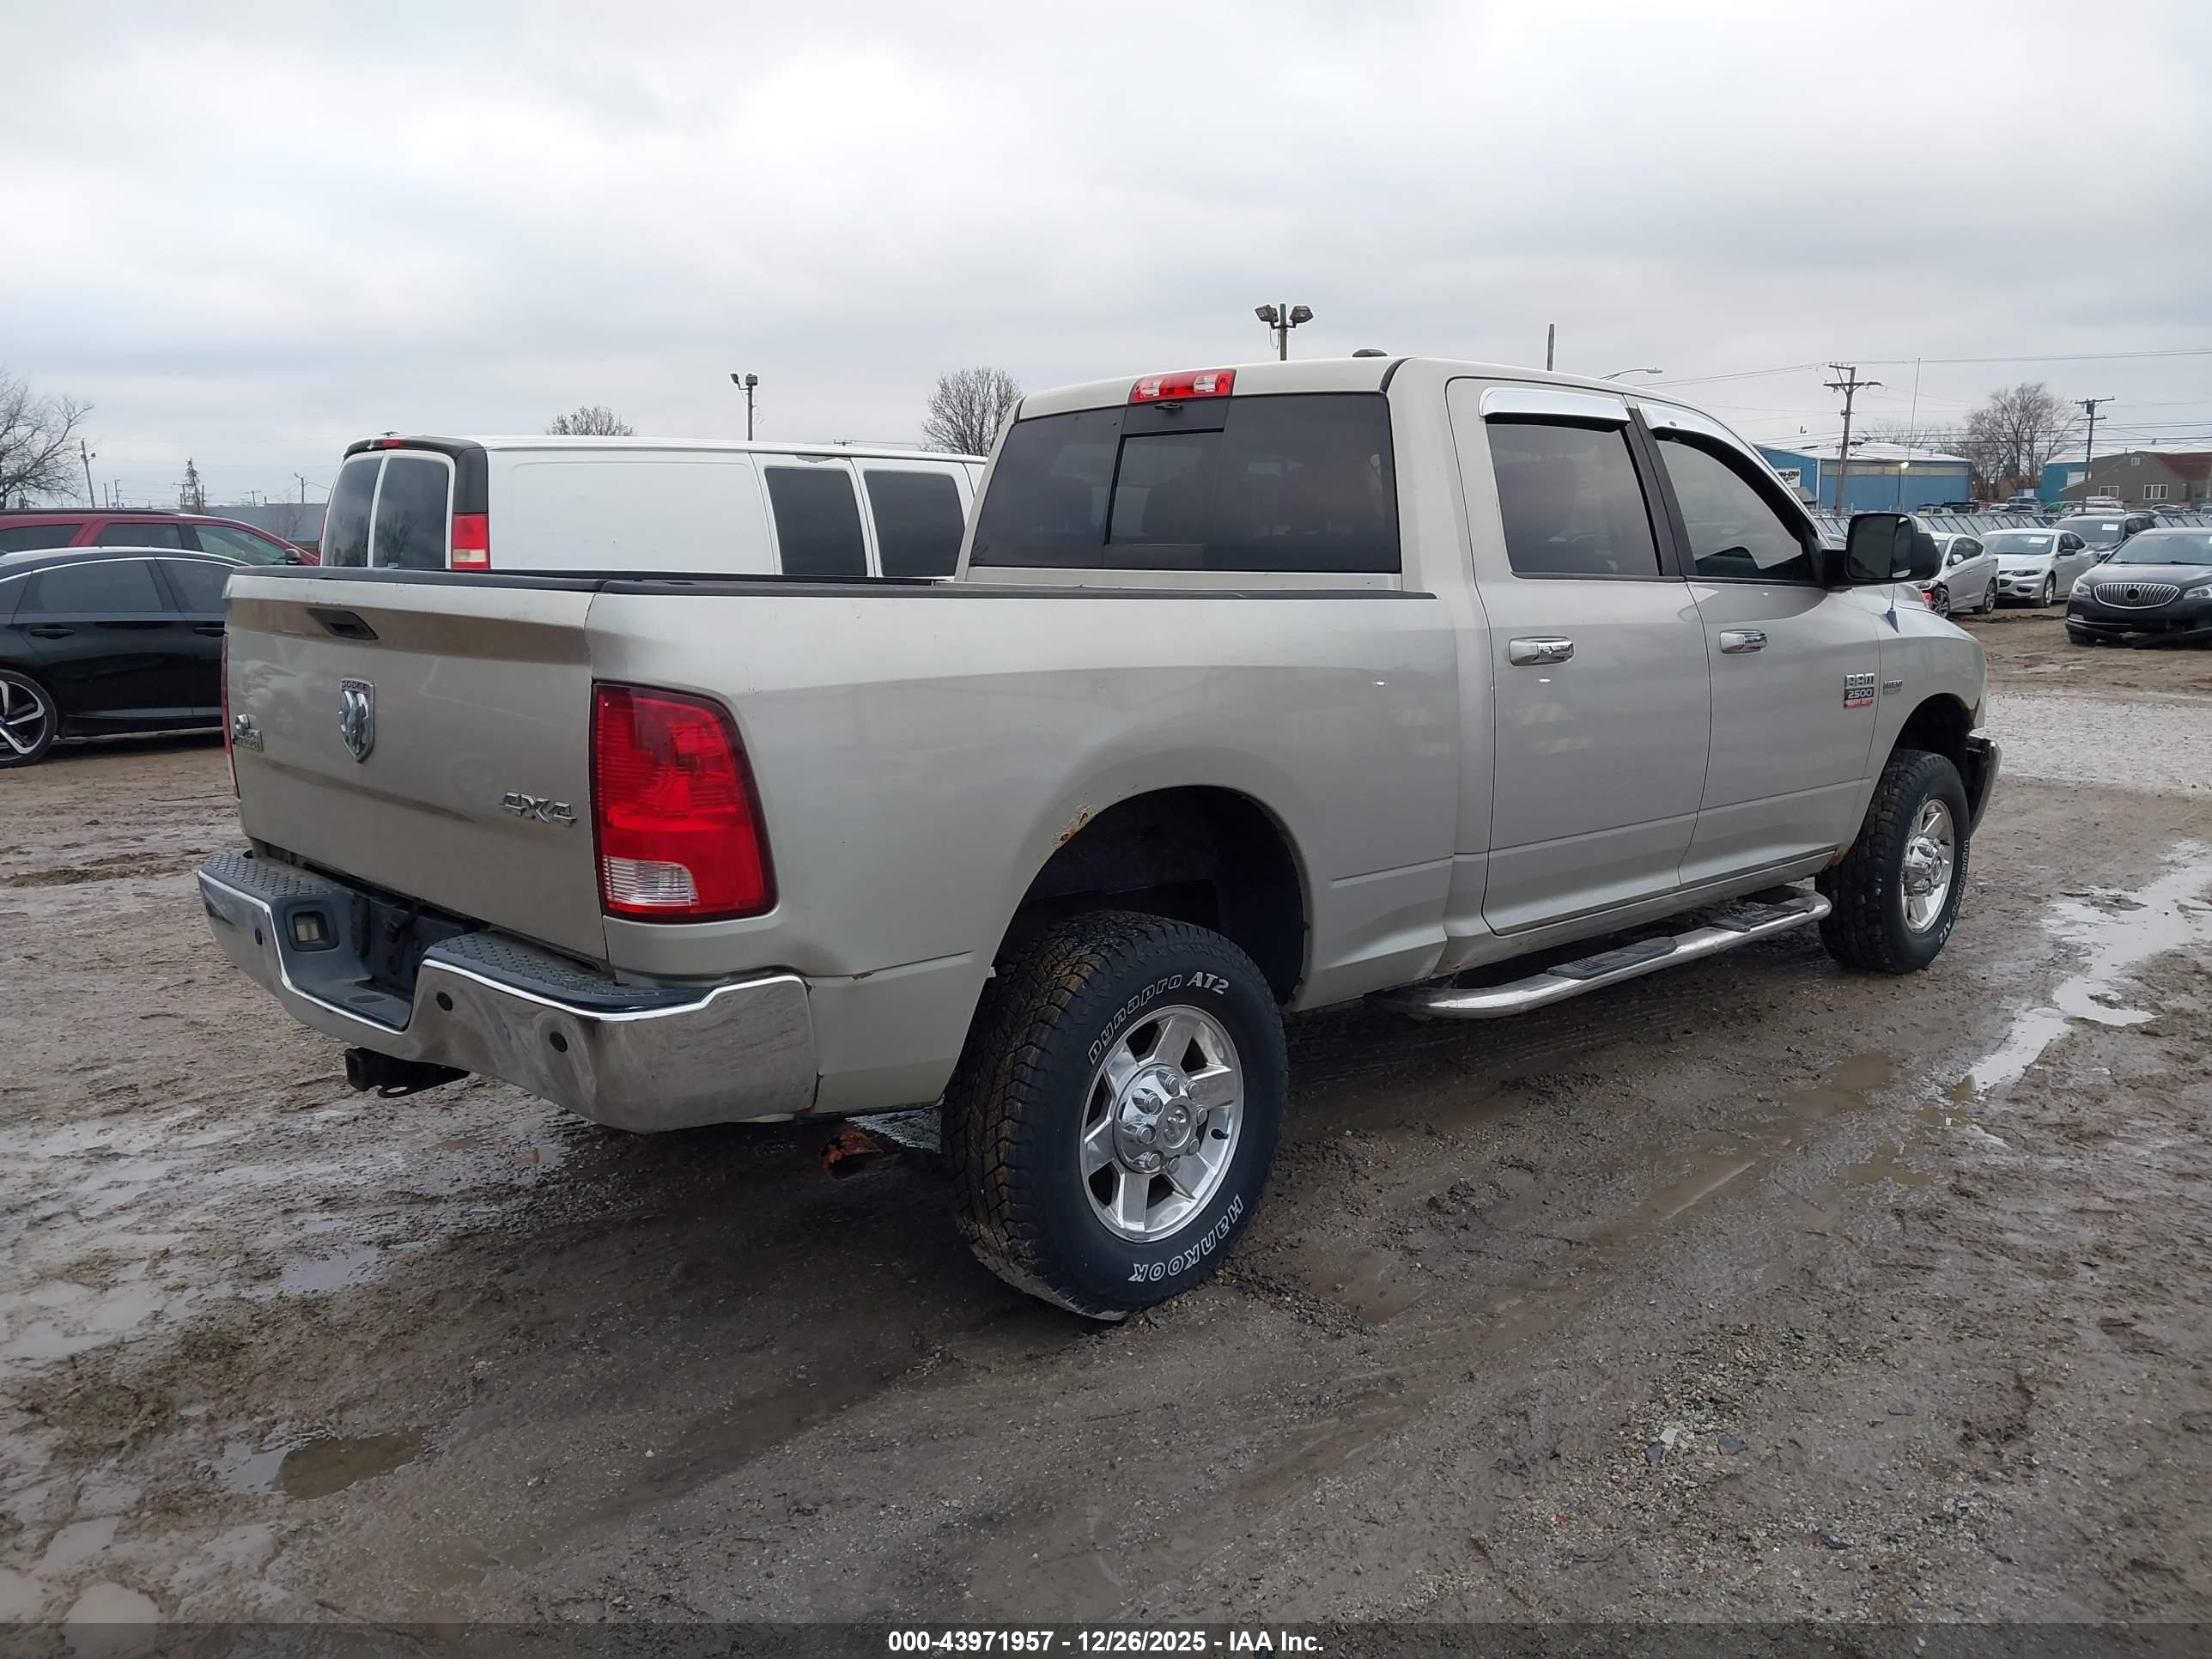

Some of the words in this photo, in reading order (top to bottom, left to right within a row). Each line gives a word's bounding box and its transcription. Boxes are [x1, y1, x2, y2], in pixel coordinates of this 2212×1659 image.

[341, 679, 369, 692] DODGE
[1847, 689, 1874, 699] 2500
[1187, 971, 1230, 995] AT2
